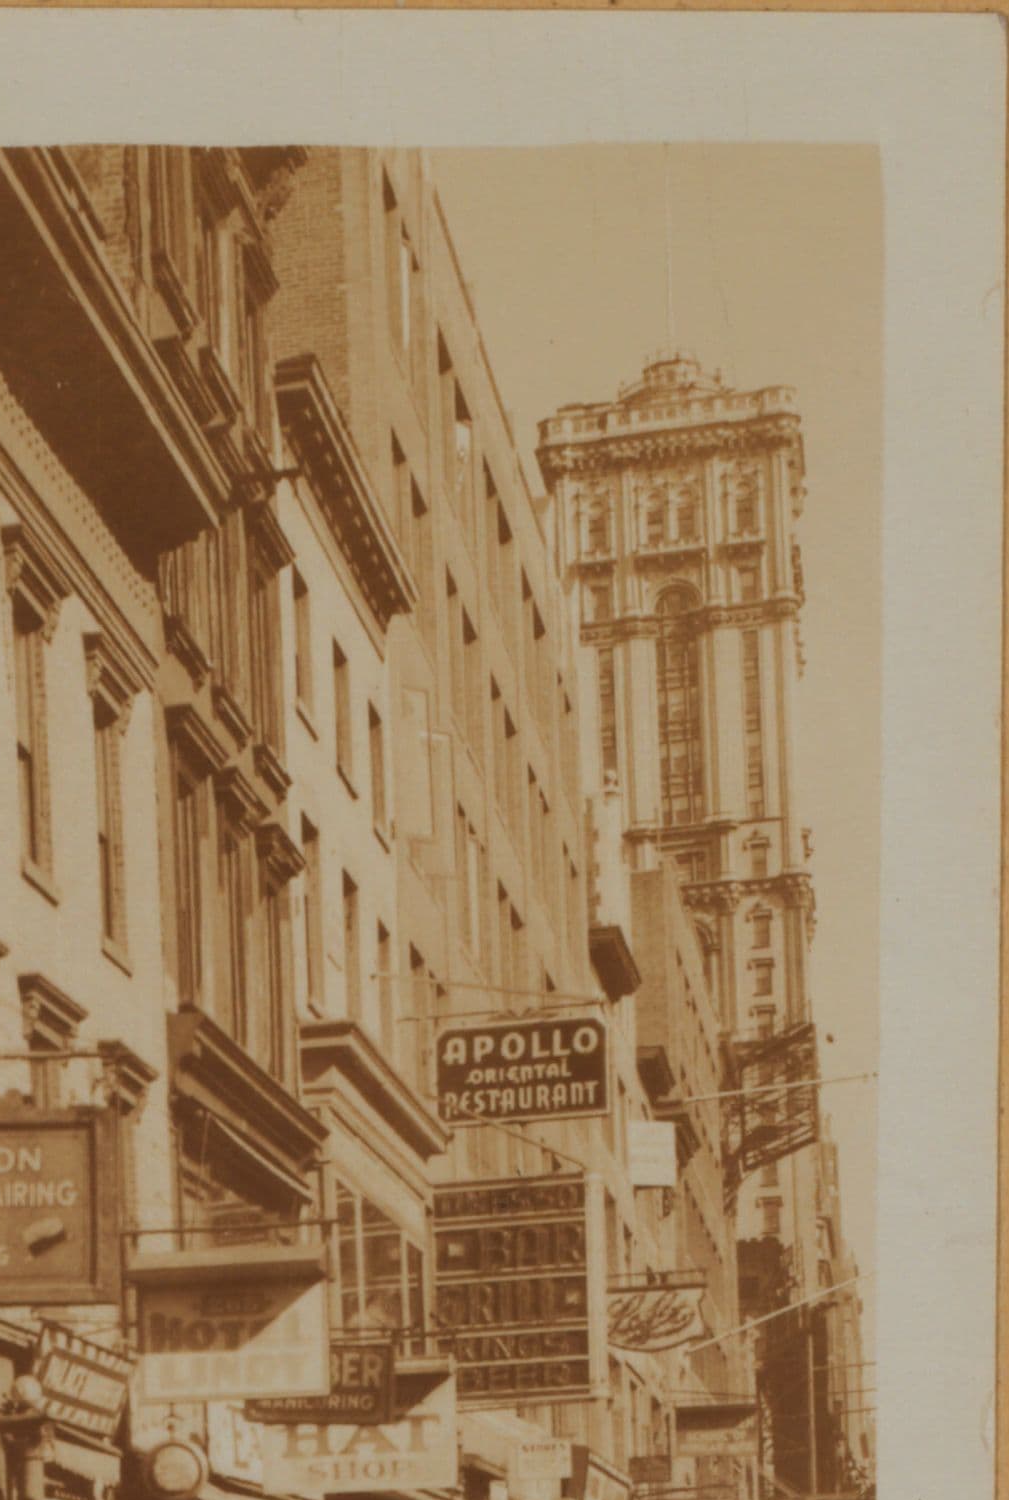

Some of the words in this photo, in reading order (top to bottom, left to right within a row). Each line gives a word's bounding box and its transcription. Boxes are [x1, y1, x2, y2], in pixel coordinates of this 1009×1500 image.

[443, 1027, 598, 1065] APOLLO
[465, 1057, 573, 1085] ORIENTAL
[444, 1080, 599, 1119] RESTAURANT
[478, 1226, 584, 1271] BAR
[457, 1363, 570, 1390] BEER
[282, 1413, 441, 1458] HAT
[306, 1458, 416, 1481] SHOP
